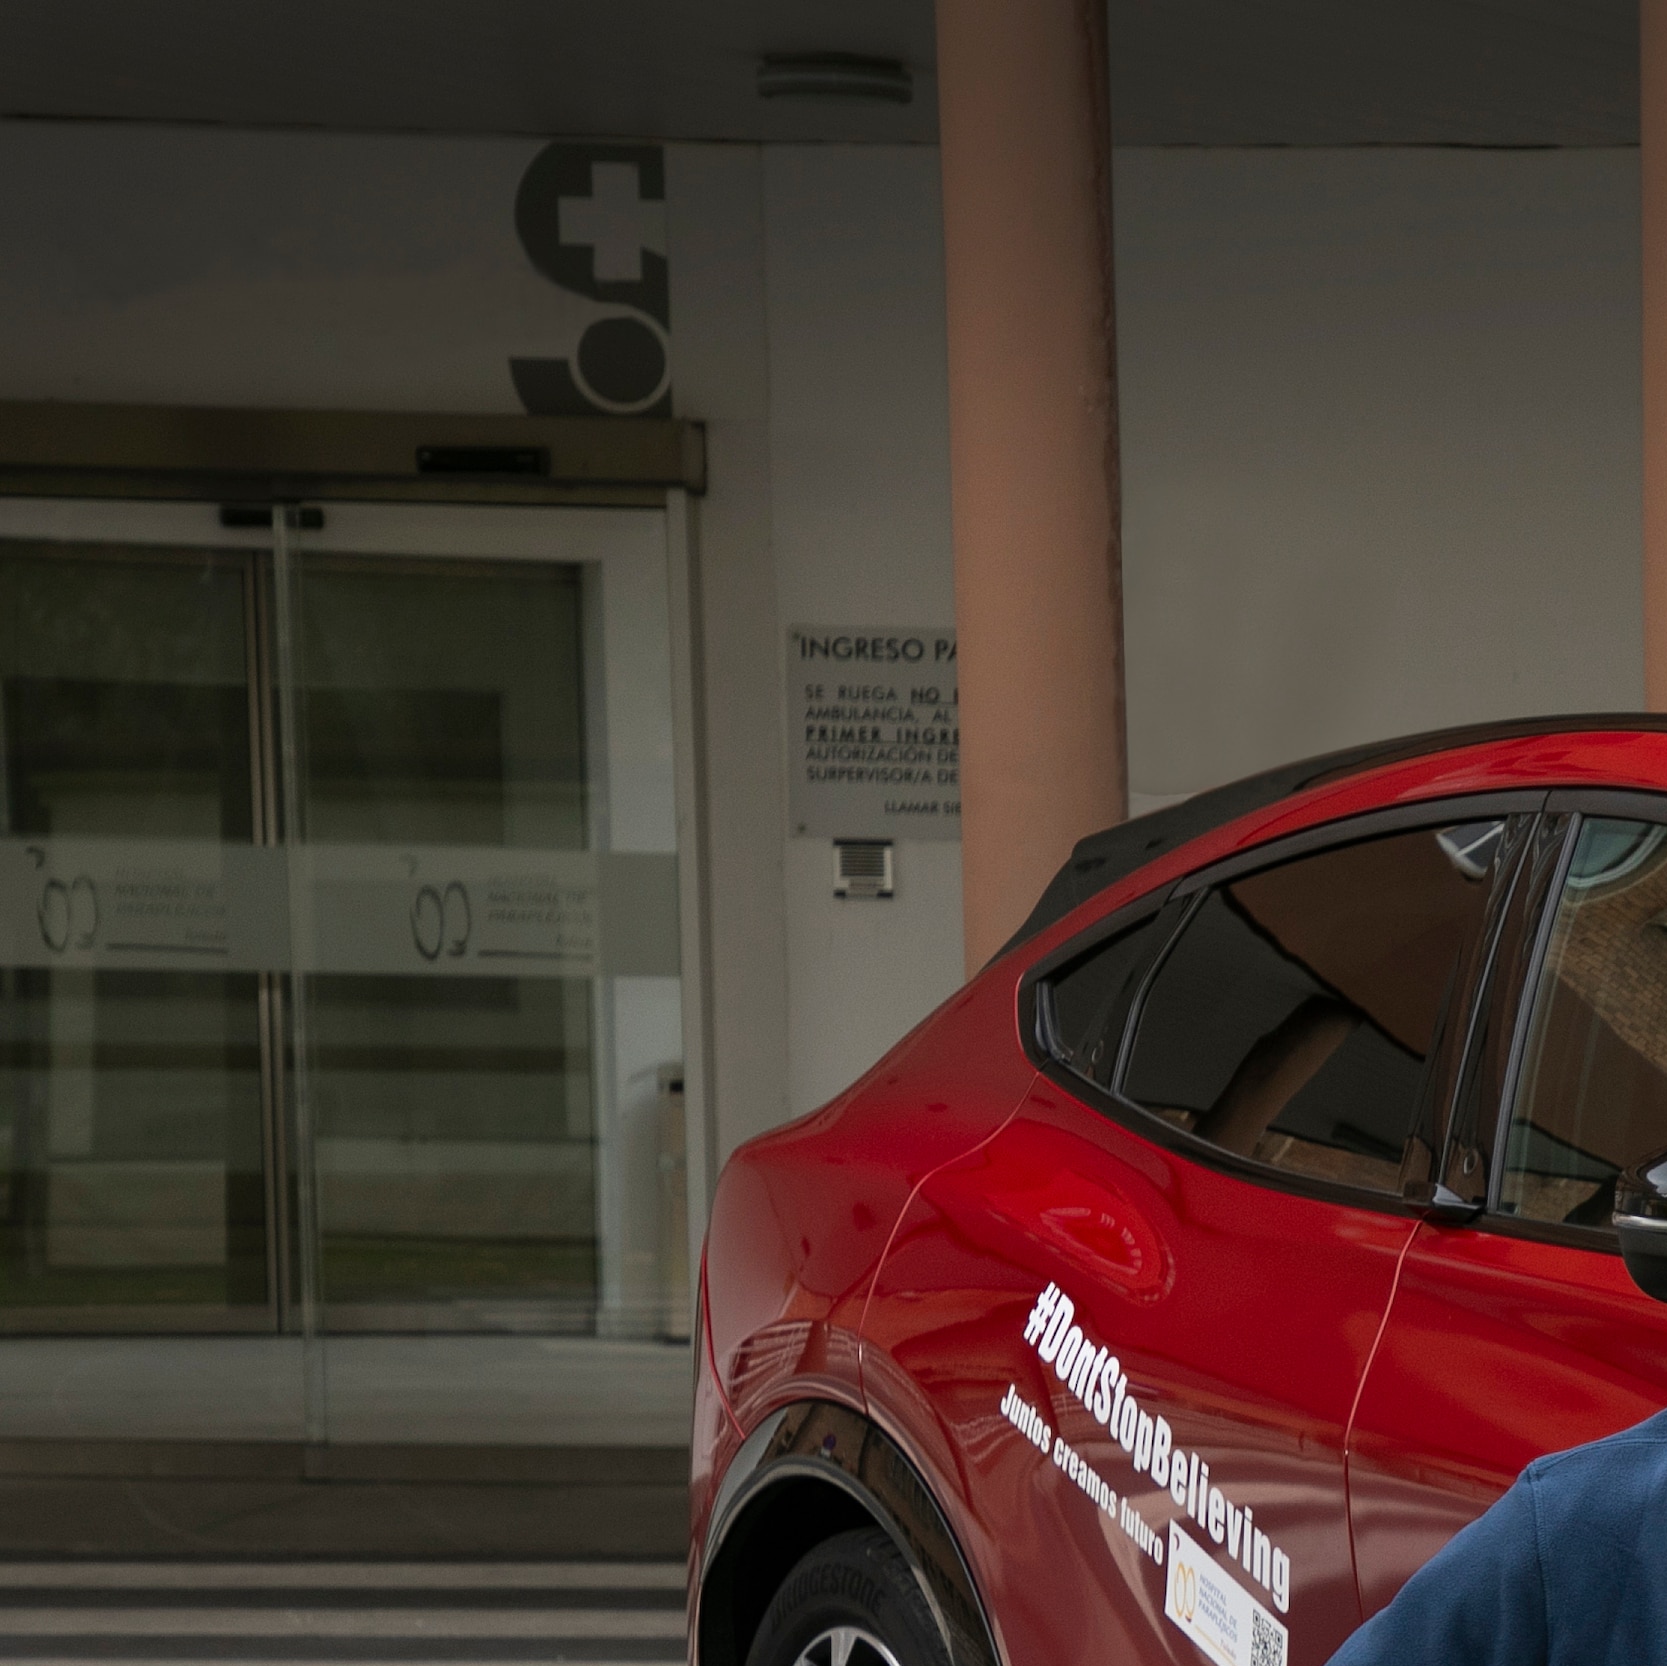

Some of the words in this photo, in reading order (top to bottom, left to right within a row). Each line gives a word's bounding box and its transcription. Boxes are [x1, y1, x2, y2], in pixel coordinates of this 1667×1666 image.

[800, 635, 925, 662] INGRESO
[804, 684, 825, 701] SE
[837, 684, 898, 702] RUEGA
[911, 686, 941, 704] NO
[932, 708, 952, 724] AL
[805, 726, 883, 744] PRIMER
[884, 800, 938, 815] LLAMAR
[1023, 1281, 1291, 1614] #DontStopBelieving
[1001, 1383, 1052, 1454] Juntos
[1052, 1436, 1118, 1519] creamos
[1120, 1496, 1164, 1567] futuro
[1199, 1573, 1227, 1607] HOSPITAL
[1198, 1586, 1227, 1622] NACIONAL
